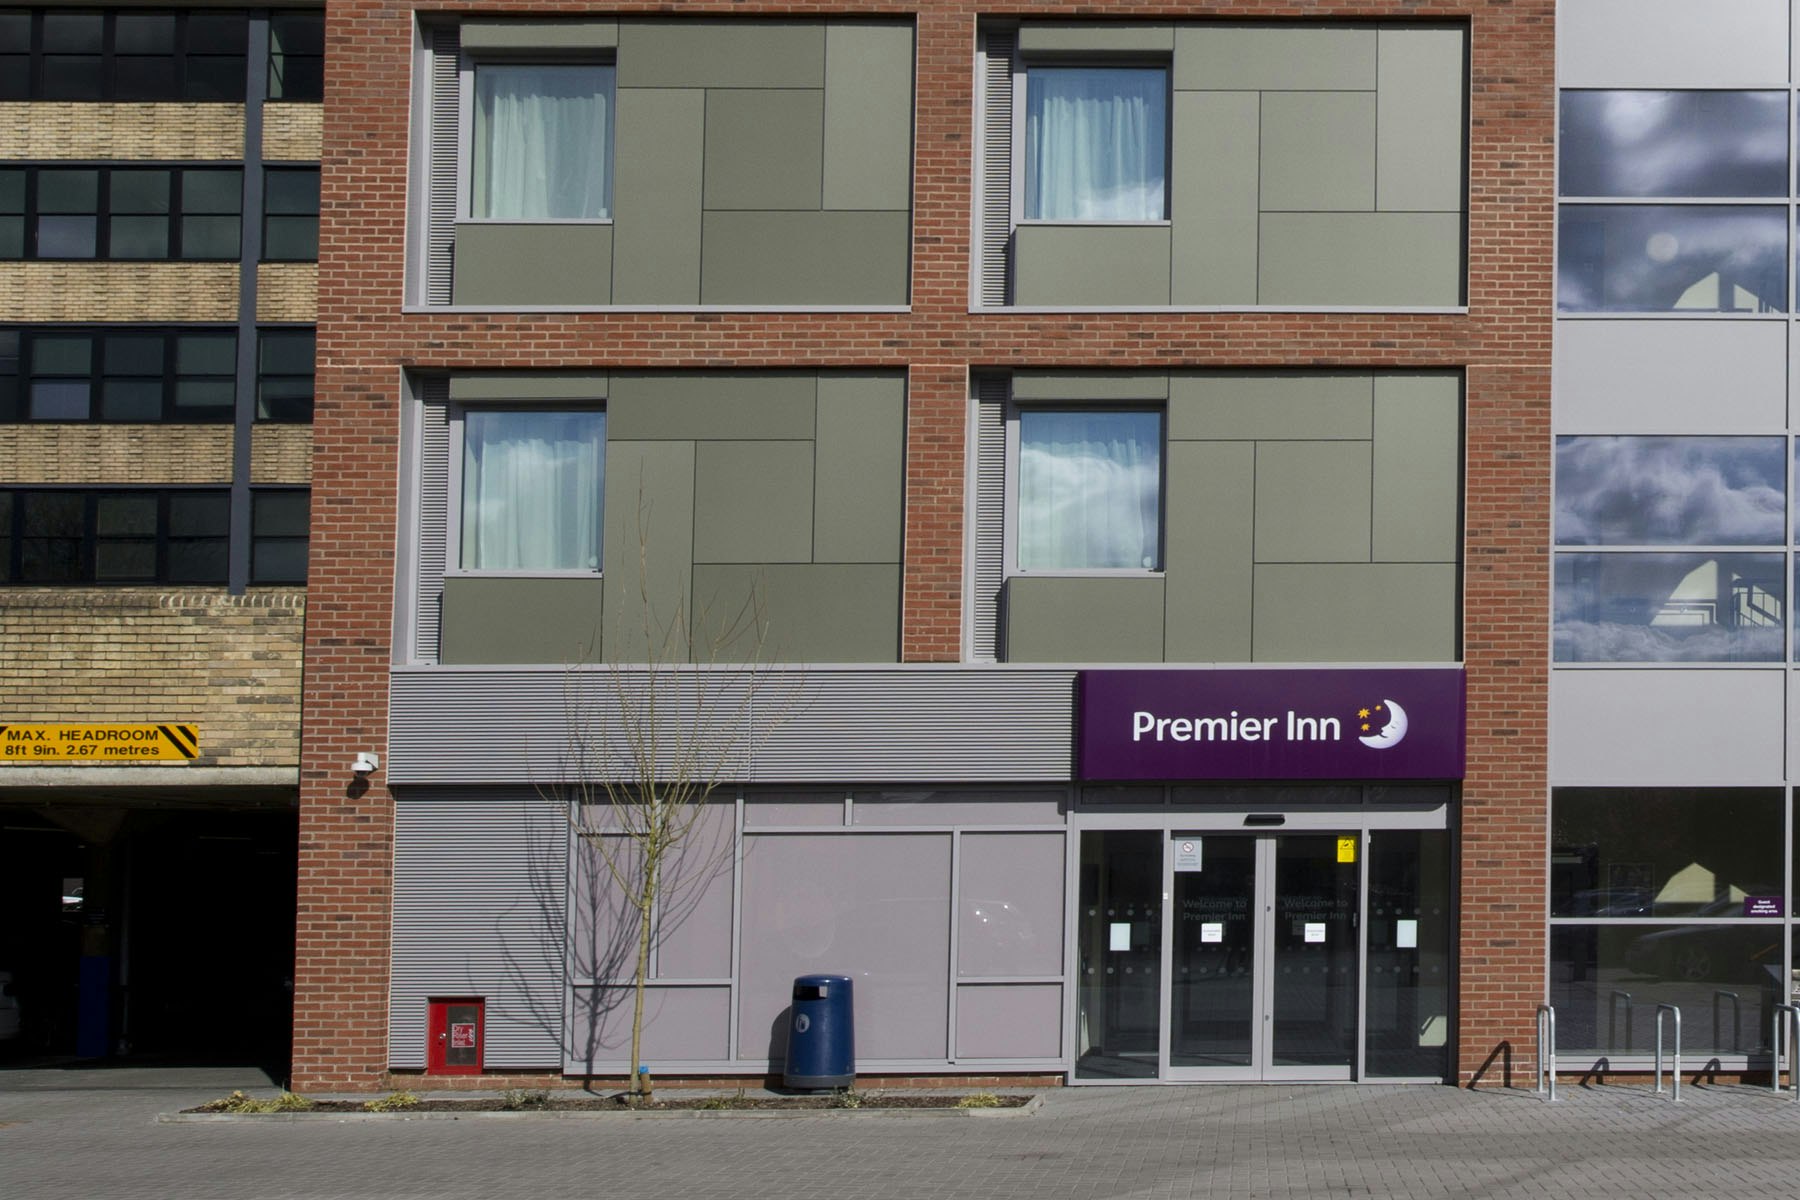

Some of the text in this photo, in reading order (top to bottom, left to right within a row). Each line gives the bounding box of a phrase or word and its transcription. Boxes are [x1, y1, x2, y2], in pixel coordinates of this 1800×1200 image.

[1132, 710, 1341, 742] Premier Inn
[7, 729, 159, 741] MAX. HEADROOM
[4, 744, 160, 756] 8ft 9in. 2.67 metres
